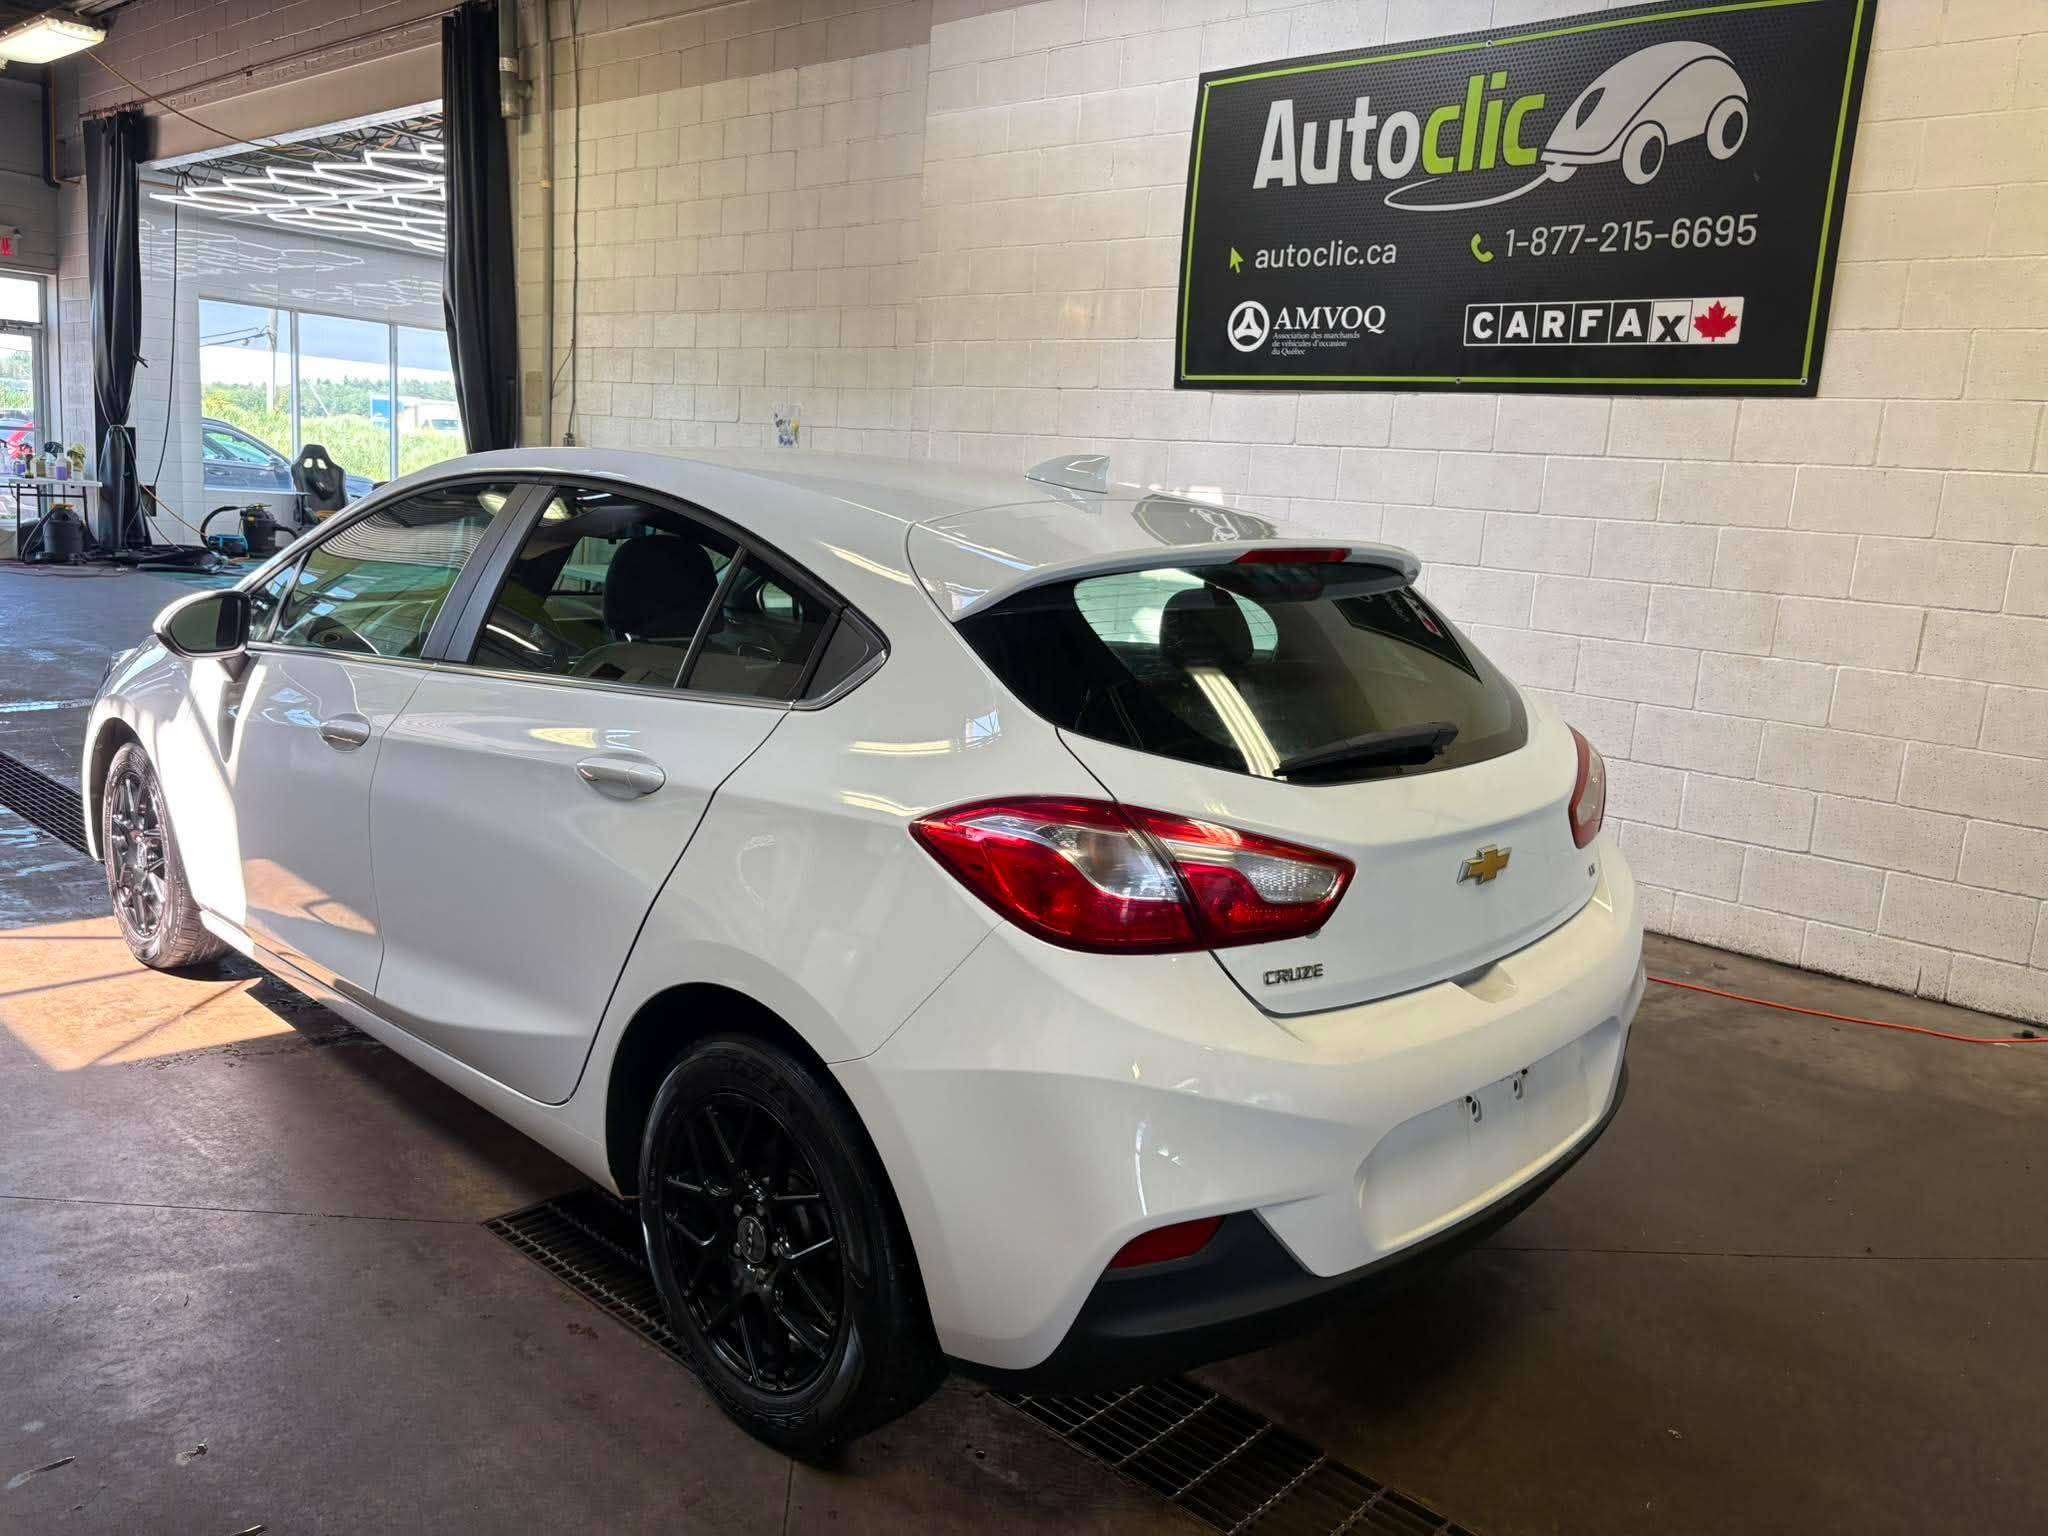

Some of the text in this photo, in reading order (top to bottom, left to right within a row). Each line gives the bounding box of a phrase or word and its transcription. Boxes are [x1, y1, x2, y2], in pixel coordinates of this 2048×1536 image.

[1252, 71, 1546, 189] Autoclic
[1504, 213, 1758, 257] 1-877-215-6695
[1255, 240, 1397, 269] autoclic.ca
[1273, 305, 1386, 334] AMVOQ
[1472, 307, 1686, 343] CARFAX
[1311, 331, 1322, 339] des
[1264, 963, 1323, 985] CRUZE
